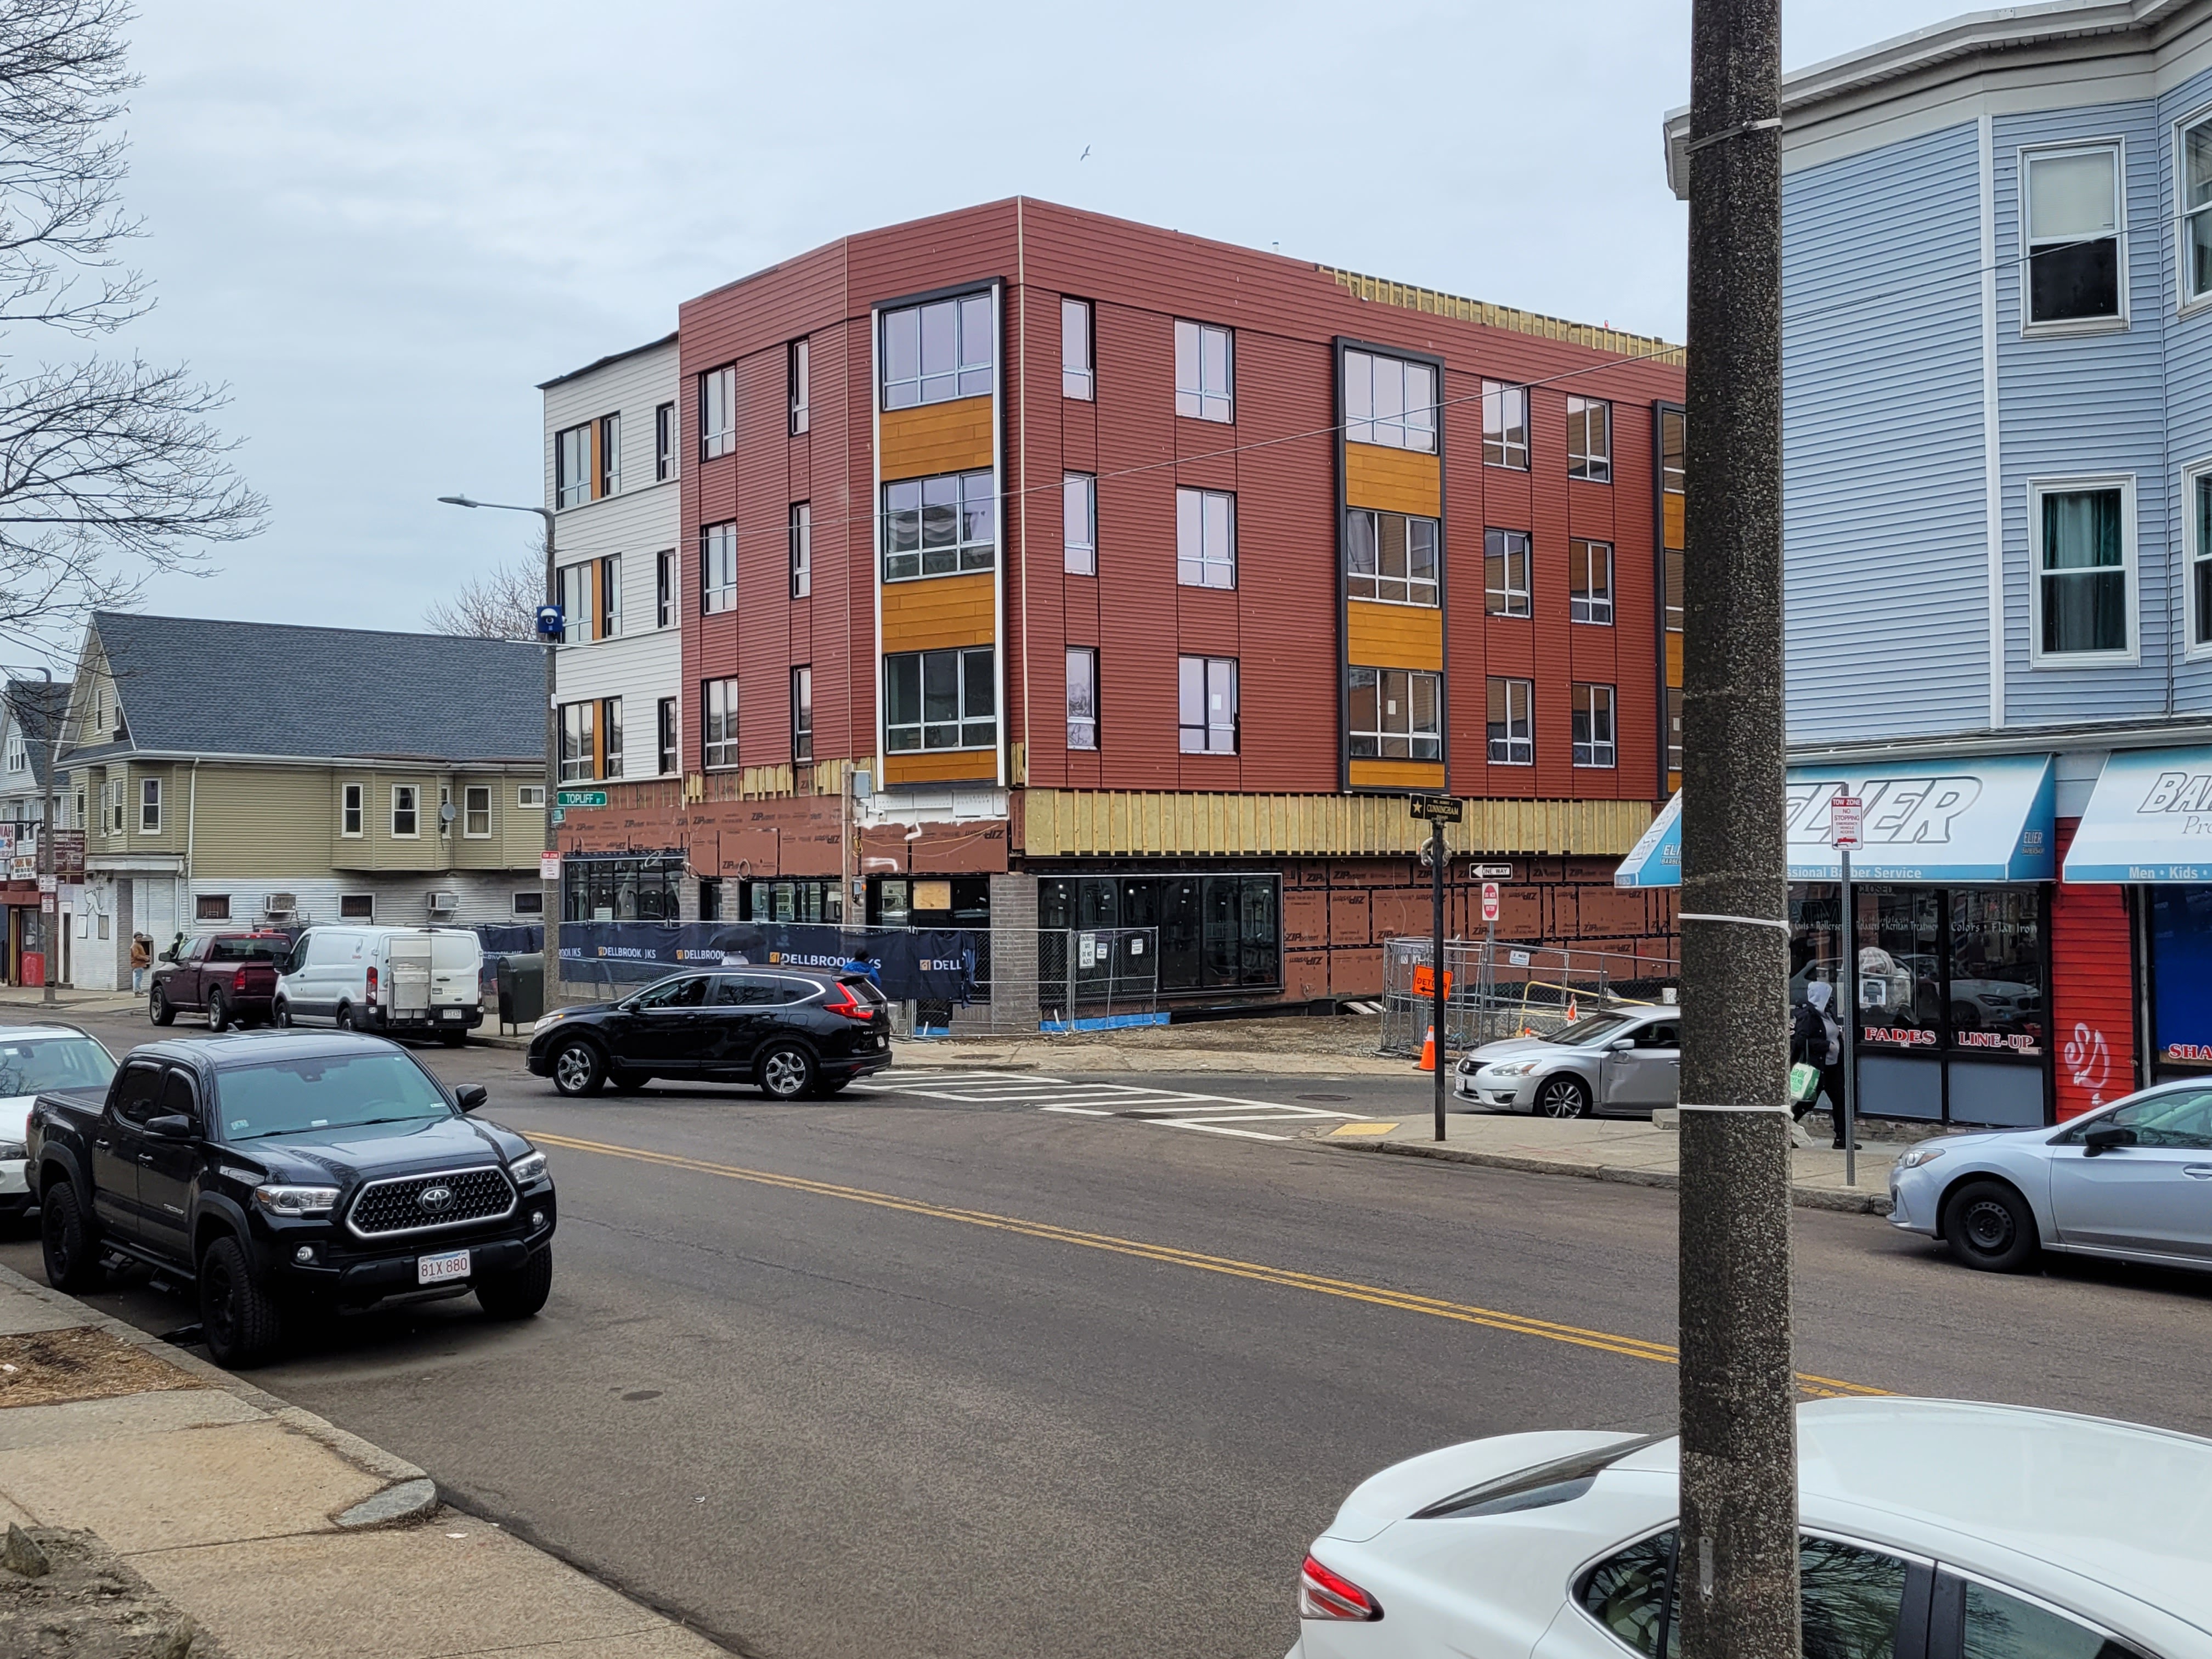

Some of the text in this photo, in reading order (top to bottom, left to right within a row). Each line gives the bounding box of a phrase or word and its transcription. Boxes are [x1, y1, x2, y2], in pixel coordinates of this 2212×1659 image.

[566, 793, 594, 804] TOPLIFF
[1427, 804, 1459, 815] CUNNINGHAM
[2023, 832, 2042, 844] ELIER
[1333, 870, 1349, 879] ZIP
[1830, 867, 1870, 878] Baber
[1874, 867, 1922, 878] Service
[2129, 866, 2198, 879] Men Kids
[1858, 884, 1893, 894] CLOSED
[1348, 895, 1366, 905] ZIP
[1816, 921, 1842, 931] Rollerse
[1951, 922, 1980, 932] Colors
[1992, 922, 2012, 933] Flat
[2017, 922, 2037, 933] Iron
[1285, 933, 1301, 941] ZIP
[602, 947, 657, 959] DELLBROOK JKS
[684, 949, 726, 960] DELLBROOK
[781, 953, 854, 968] DELLBROOK
[933, 960, 962, 970] DELL
[1306, 956, 1323, 966] ZIP
[1865, 1027, 1936, 1045] FADES
[1958, 1031, 2034, 1049] LINE-UP
[421, 1261, 443, 1277] 81X
[446, 1257, 467, 1273] 880
